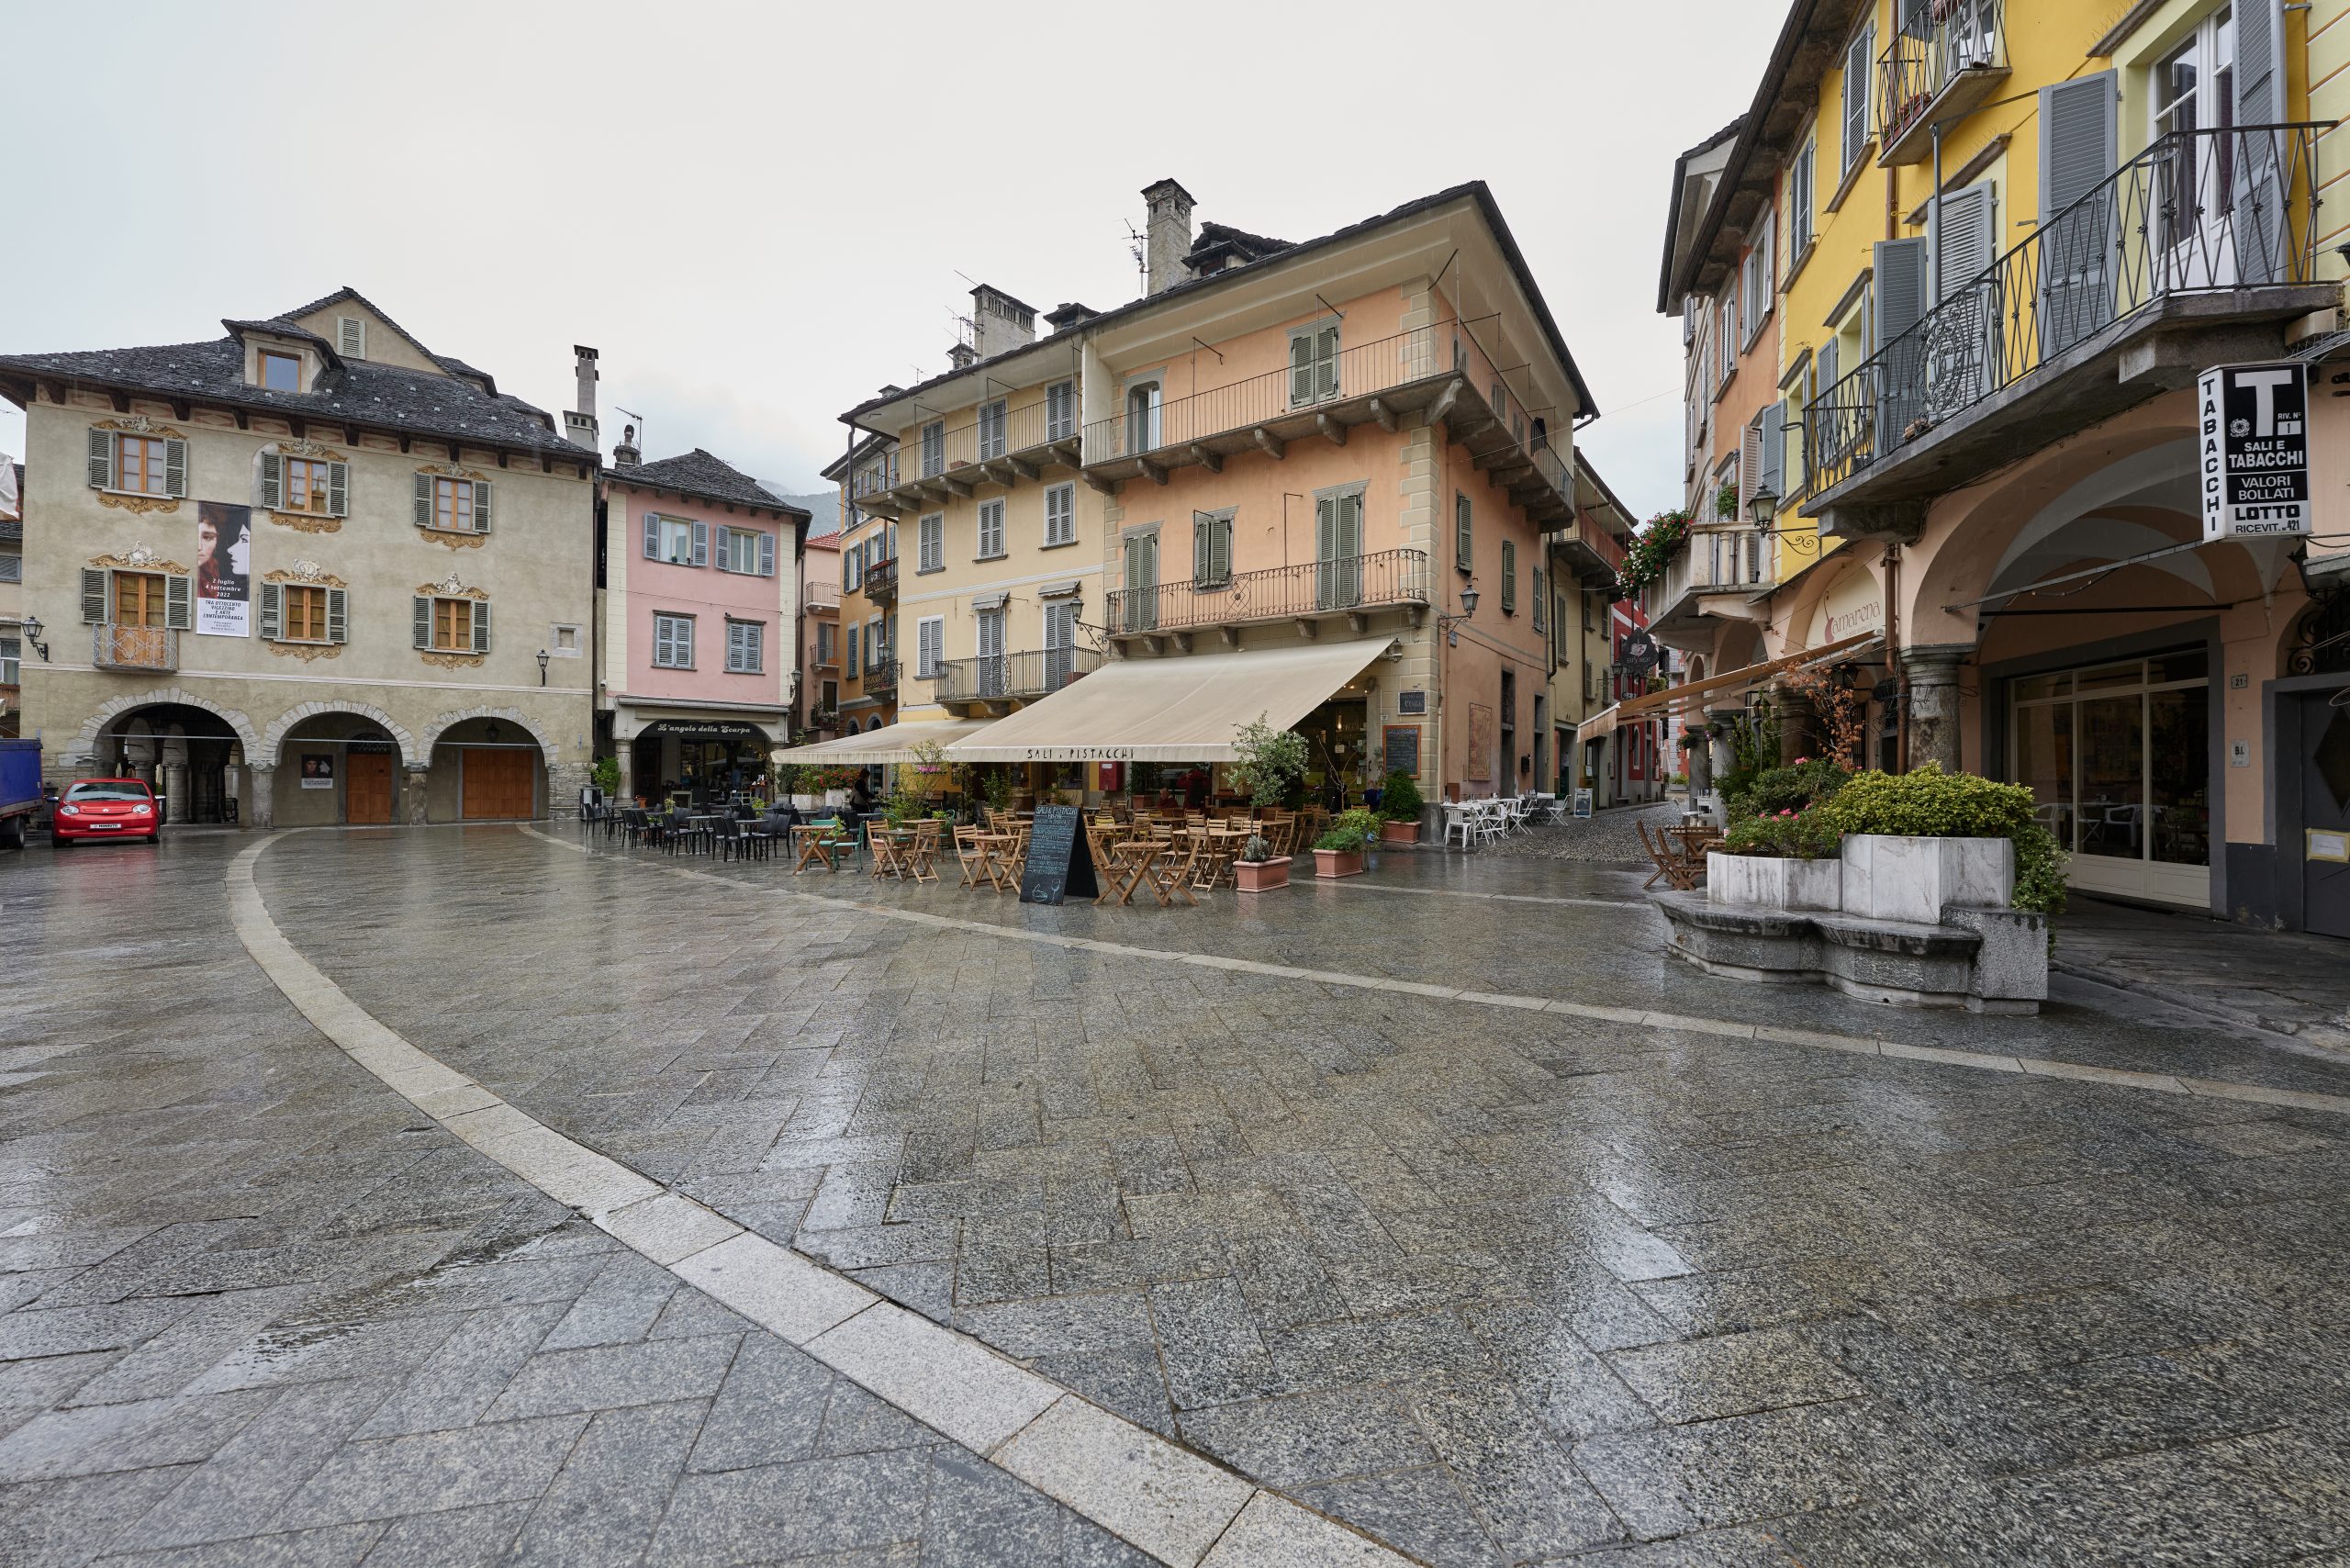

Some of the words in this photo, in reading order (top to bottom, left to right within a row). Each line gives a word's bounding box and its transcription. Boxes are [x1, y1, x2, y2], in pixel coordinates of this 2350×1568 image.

[2235, 370, 2292, 437] T
[2287, 422, 2291, 433] 1
[2244, 441, 2273, 451] SALI
[2277, 441, 2285, 450] E
[2202, 378, 2220, 532] TABACCHI
[2229, 450, 2303, 468] TABACCHI
[2241, 476, 2290, 488] VALORI
[2238, 487, 2294, 500] BOLLATI
[2234, 505, 2300, 521] LOTTO
[1832, 601, 1881, 634] amarena
[1027, 748, 1052, 759] SALI
[1069, 748, 1135, 759] PISTACCHI
